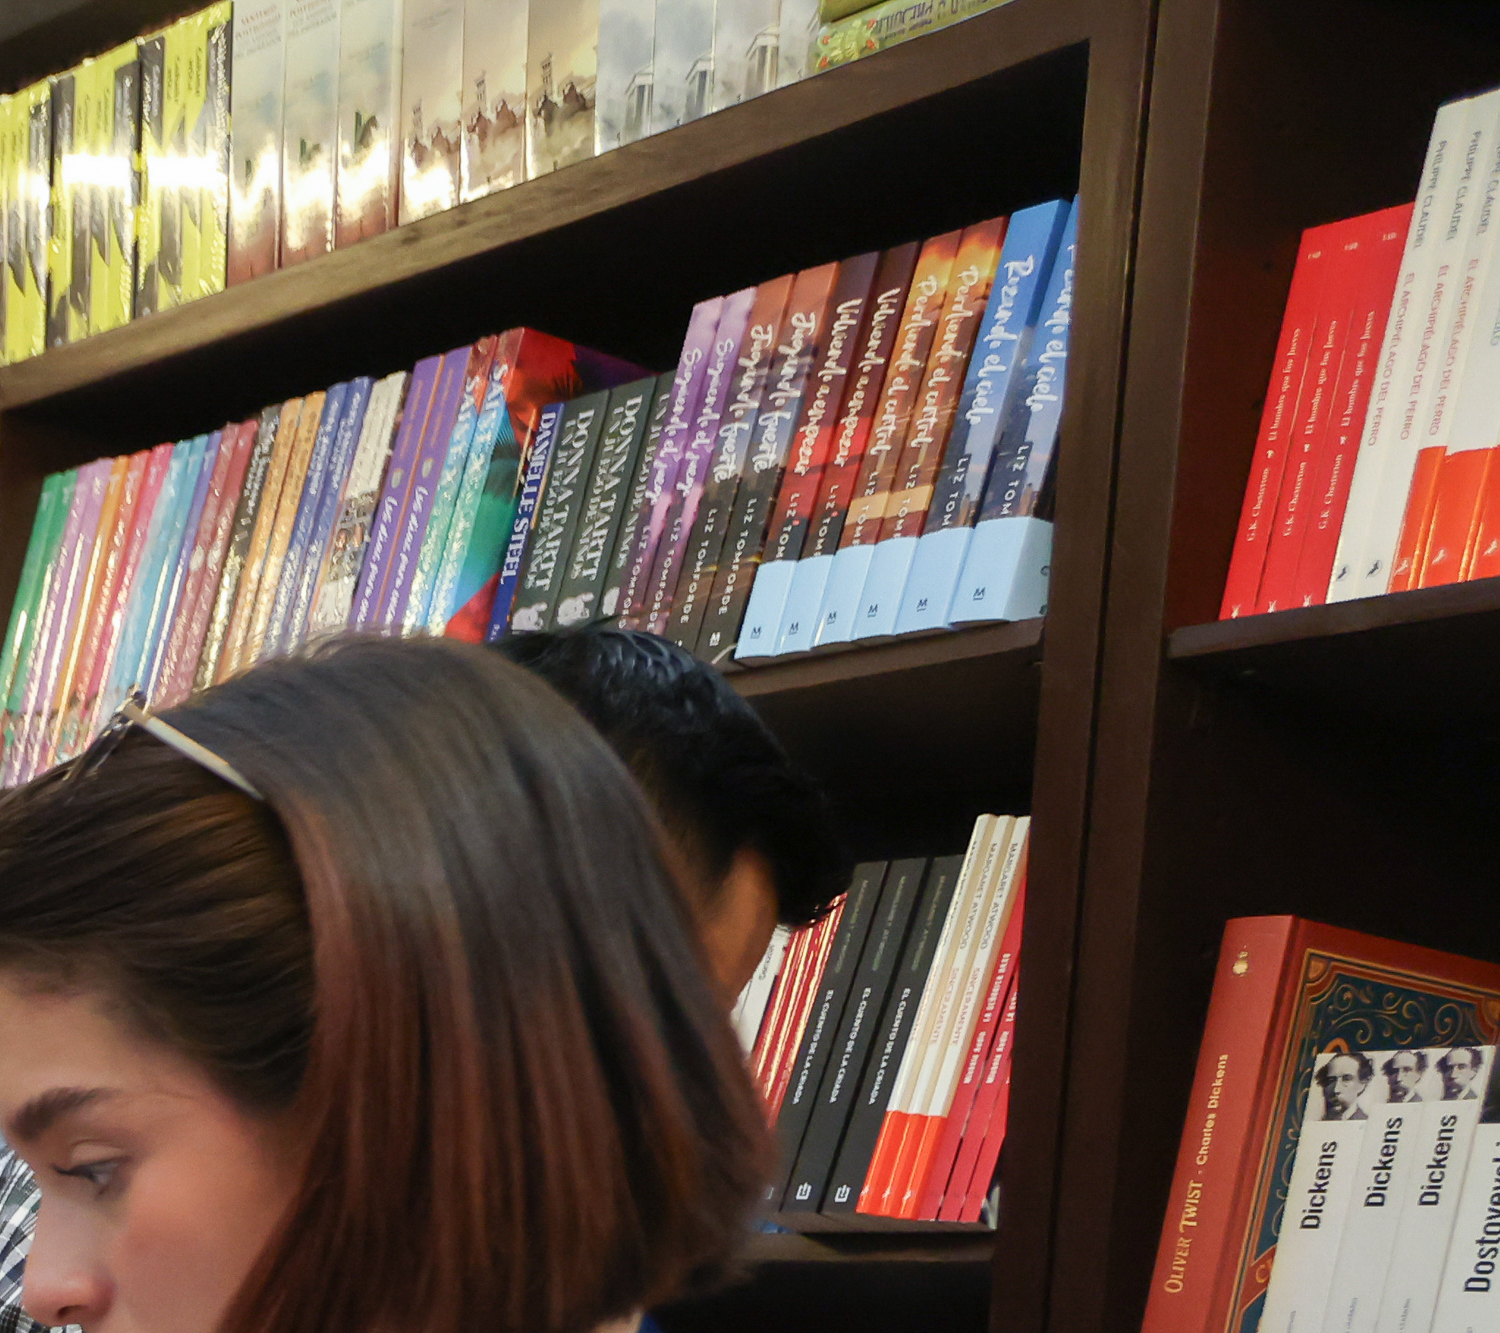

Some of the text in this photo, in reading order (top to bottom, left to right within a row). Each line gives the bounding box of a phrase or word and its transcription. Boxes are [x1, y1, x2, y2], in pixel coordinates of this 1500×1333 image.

[520, 411, 556, 513] DANIELLE
[556, 409, 595, 510] DONNA
[603, 395, 643, 498] DONNA
[1164, 1237, 1192, 1293] OLIVER
[1196, 1109, 1216, 1165] Charles
[1209, 1054, 1229, 1106] Dickens
[1300, 1140, 1337, 1231] Dickens
[1364, 1117, 1404, 1208] Dickens
[1419, 1114, 1457, 1207] Dickens
